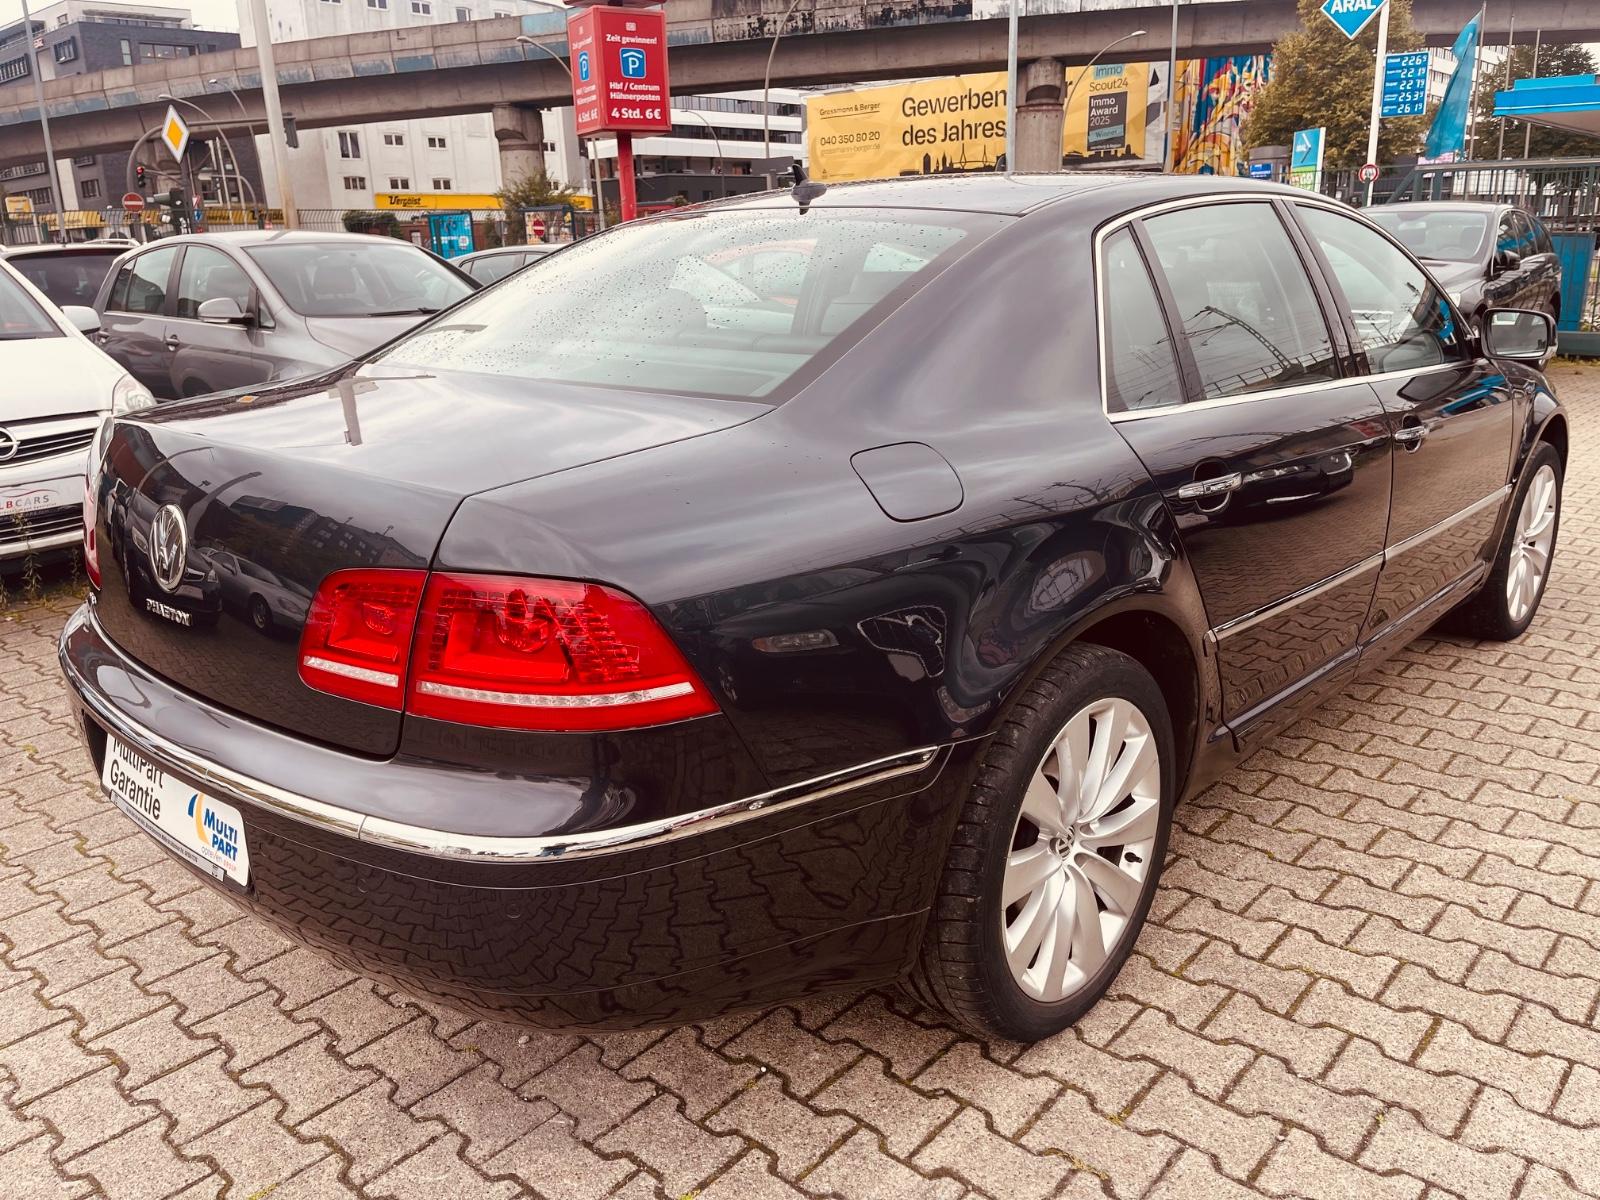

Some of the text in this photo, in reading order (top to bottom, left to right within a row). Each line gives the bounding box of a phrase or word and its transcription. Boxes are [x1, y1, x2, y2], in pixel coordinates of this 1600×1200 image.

[1330, 0, 1377, 15] ARAL
[606, 34, 657, 45] Zeit gewinnen!
[1096, 65, 1123, 77] Immo
[609, 82, 623, 90] Hbf
[629, 83, 660, 91] Centrum
[1089, 78, 1129, 92] Scout24
[610, 91, 661, 101] Hühnerposten
[1090, 97, 1116, 107] Immo
[611, 107, 661, 119] 4 Std. 6€
[854, 104, 860, 112] &
[860, 102, 881, 112] Berger
[1090, 105, 1119, 117] Award
[1090, 115, 1110, 126] 2025
[820, 131, 881, 146] 040 350 80 20
[902, 119, 1006, 146] des Jahres
[146, 598, 191, 627] PHAETON
[110, 759, 161, 820] Garantie
[212, 836, 238, 861] PART
